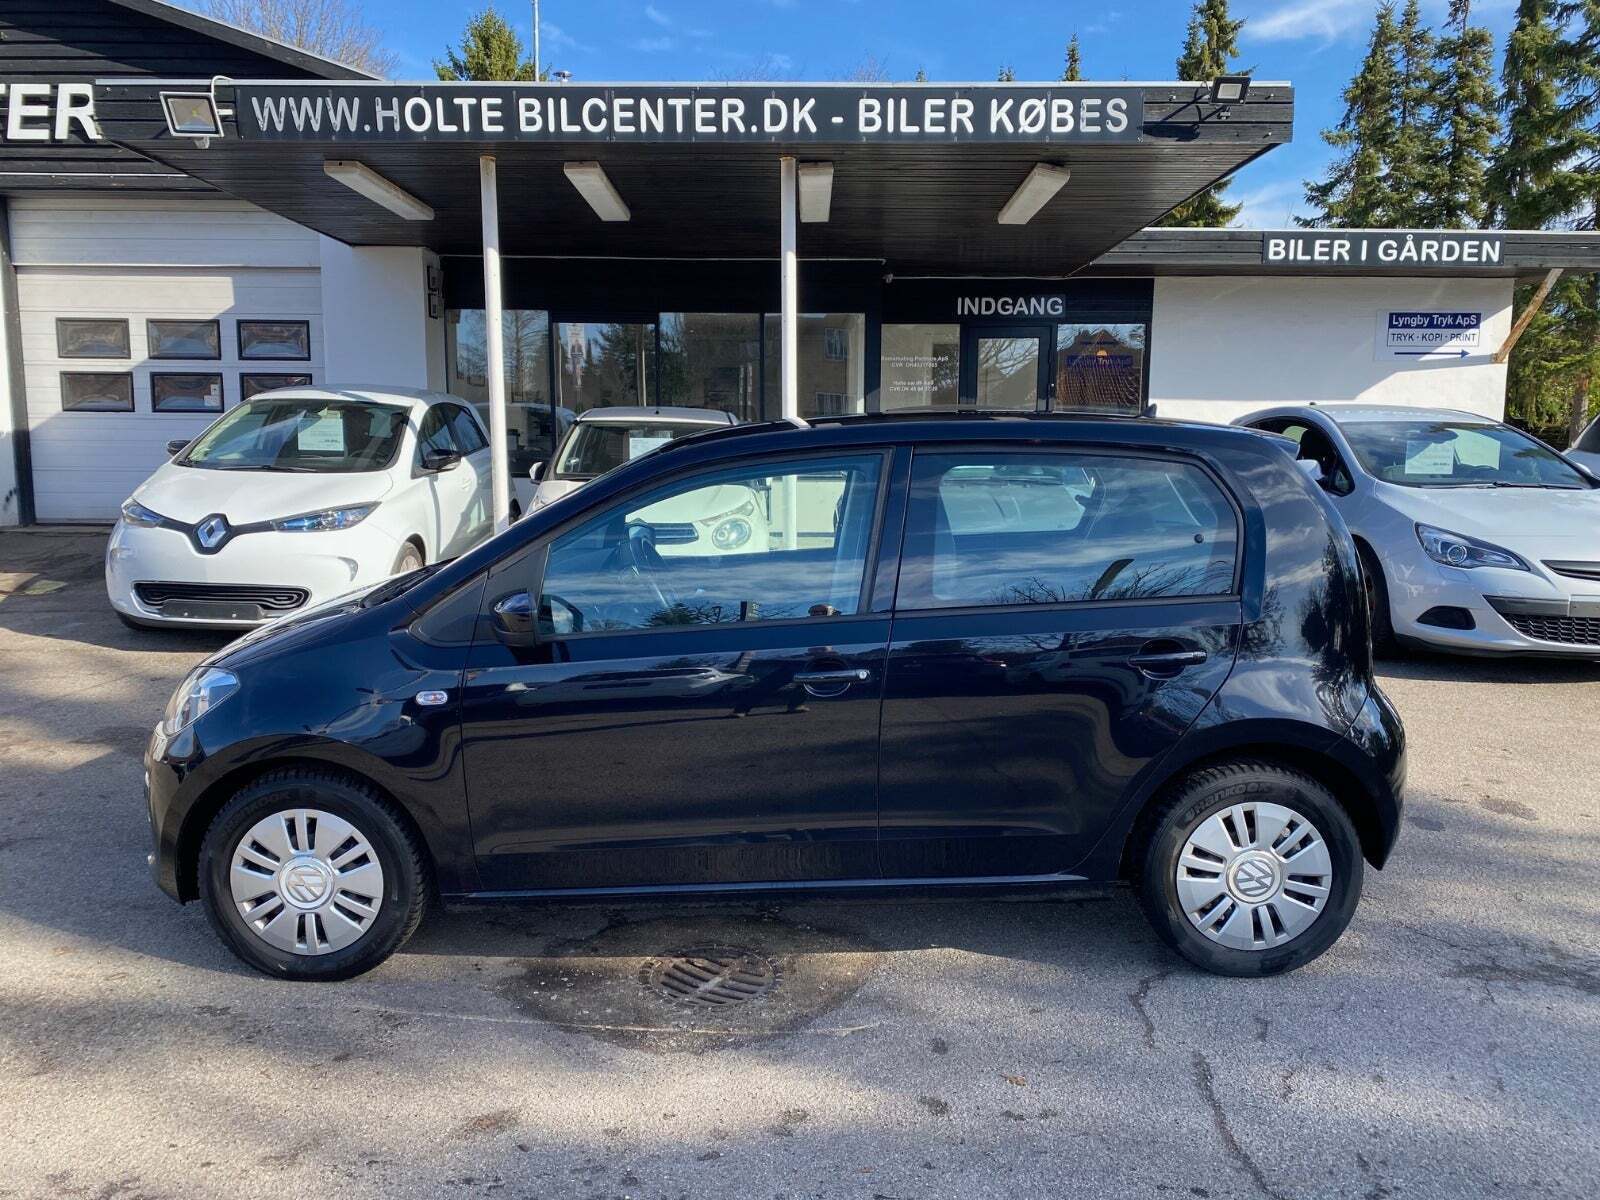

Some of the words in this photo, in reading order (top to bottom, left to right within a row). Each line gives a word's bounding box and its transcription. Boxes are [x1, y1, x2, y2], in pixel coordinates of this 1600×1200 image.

[251, 97, 504, 132] WWW.HOLTE
[518, 97, 817, 133] BILCENTER.DK
[858, 98, 974, 133] BILER
[990, 98, 1128, 133] KØBES
[1268, 239, 1351, 261] BILER
[1361, 239, 1367, 261] I
[1378, 234, 1500, 262] GÅRDEN
[957, 297, 1063, 315] INDGANG
[1392, 315, 1429, 327] Lyngby
[1432, 315, 1453, 327] Tryk
[1455, 315, 1477, 326] ApS
[1391, 333, 1415, 341] TRYK
[1421, 333, 1443, 342] KOPI
[1450, 333, 1477, 342] PRINT
